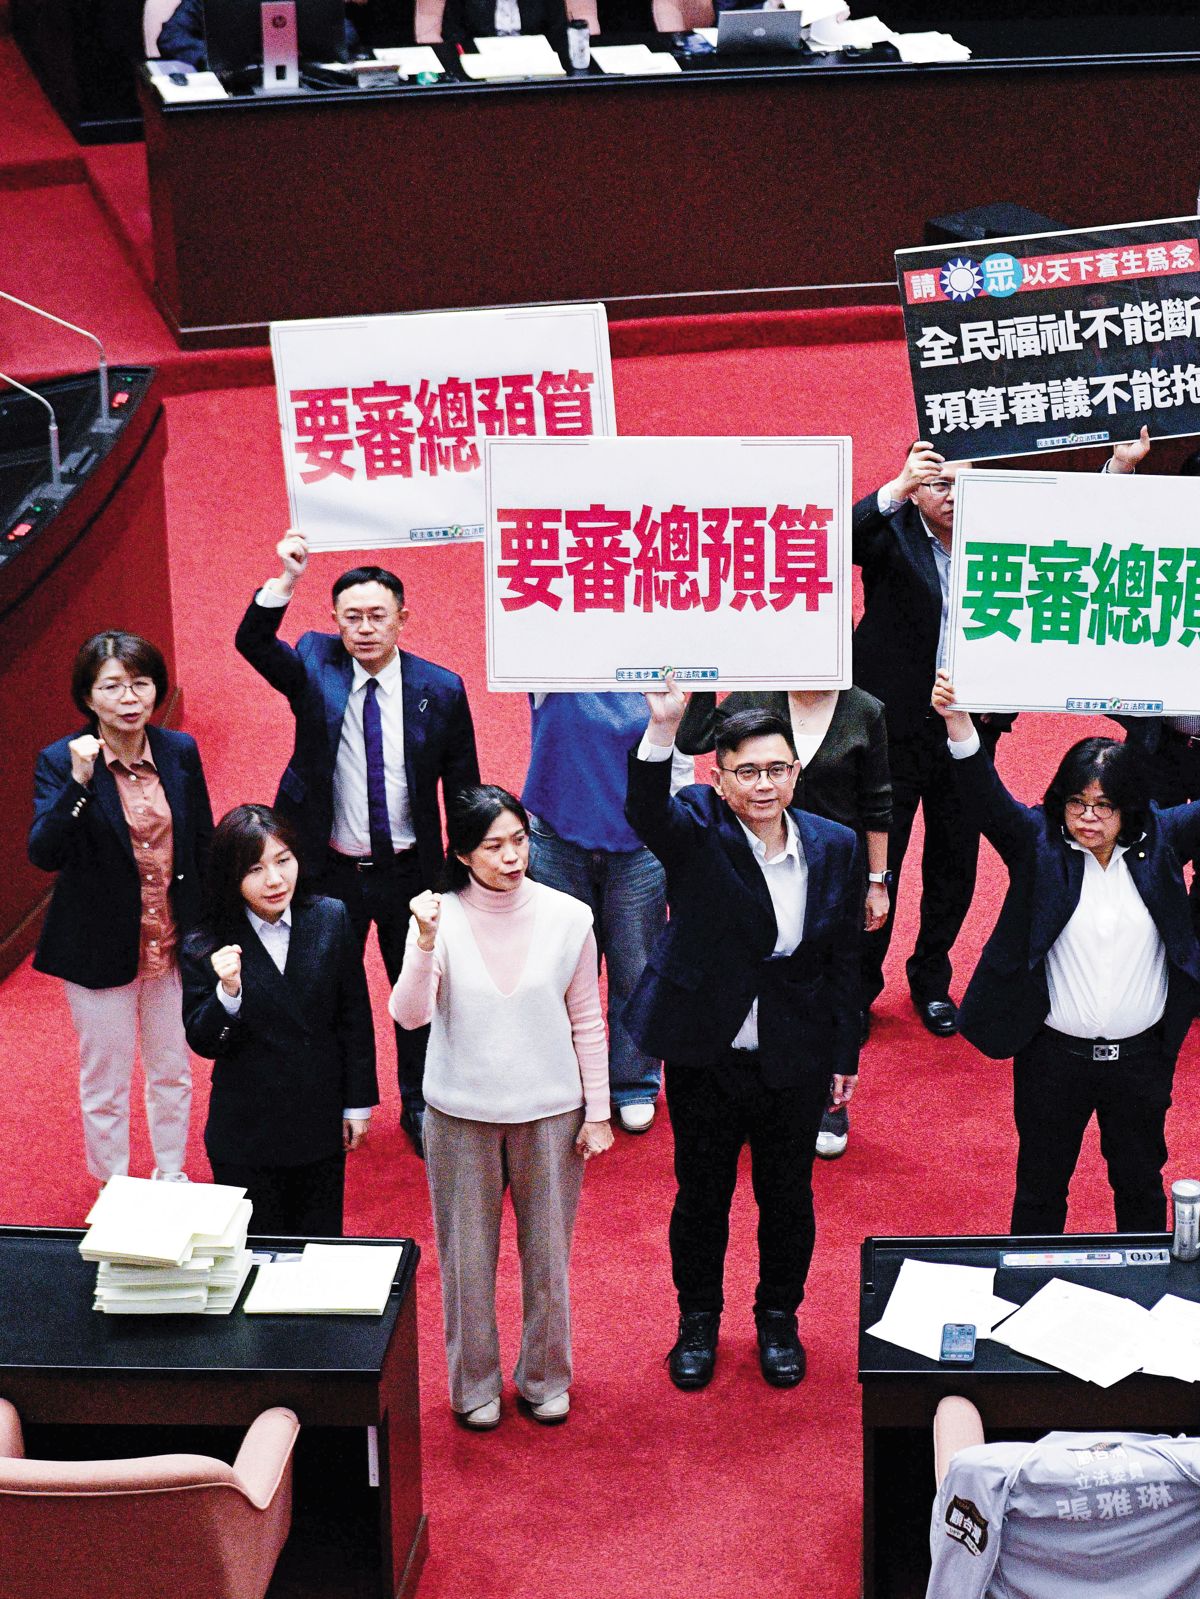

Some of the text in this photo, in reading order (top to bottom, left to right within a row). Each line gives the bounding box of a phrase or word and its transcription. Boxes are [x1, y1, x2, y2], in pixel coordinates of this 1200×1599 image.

[911, 273, 936, 299] 請
[497, 504, 833, 613] 要審總預算
[1130, 1251, 1166, 1262] 004
[1055, 1480, 1174, 1521] 張雅琳
